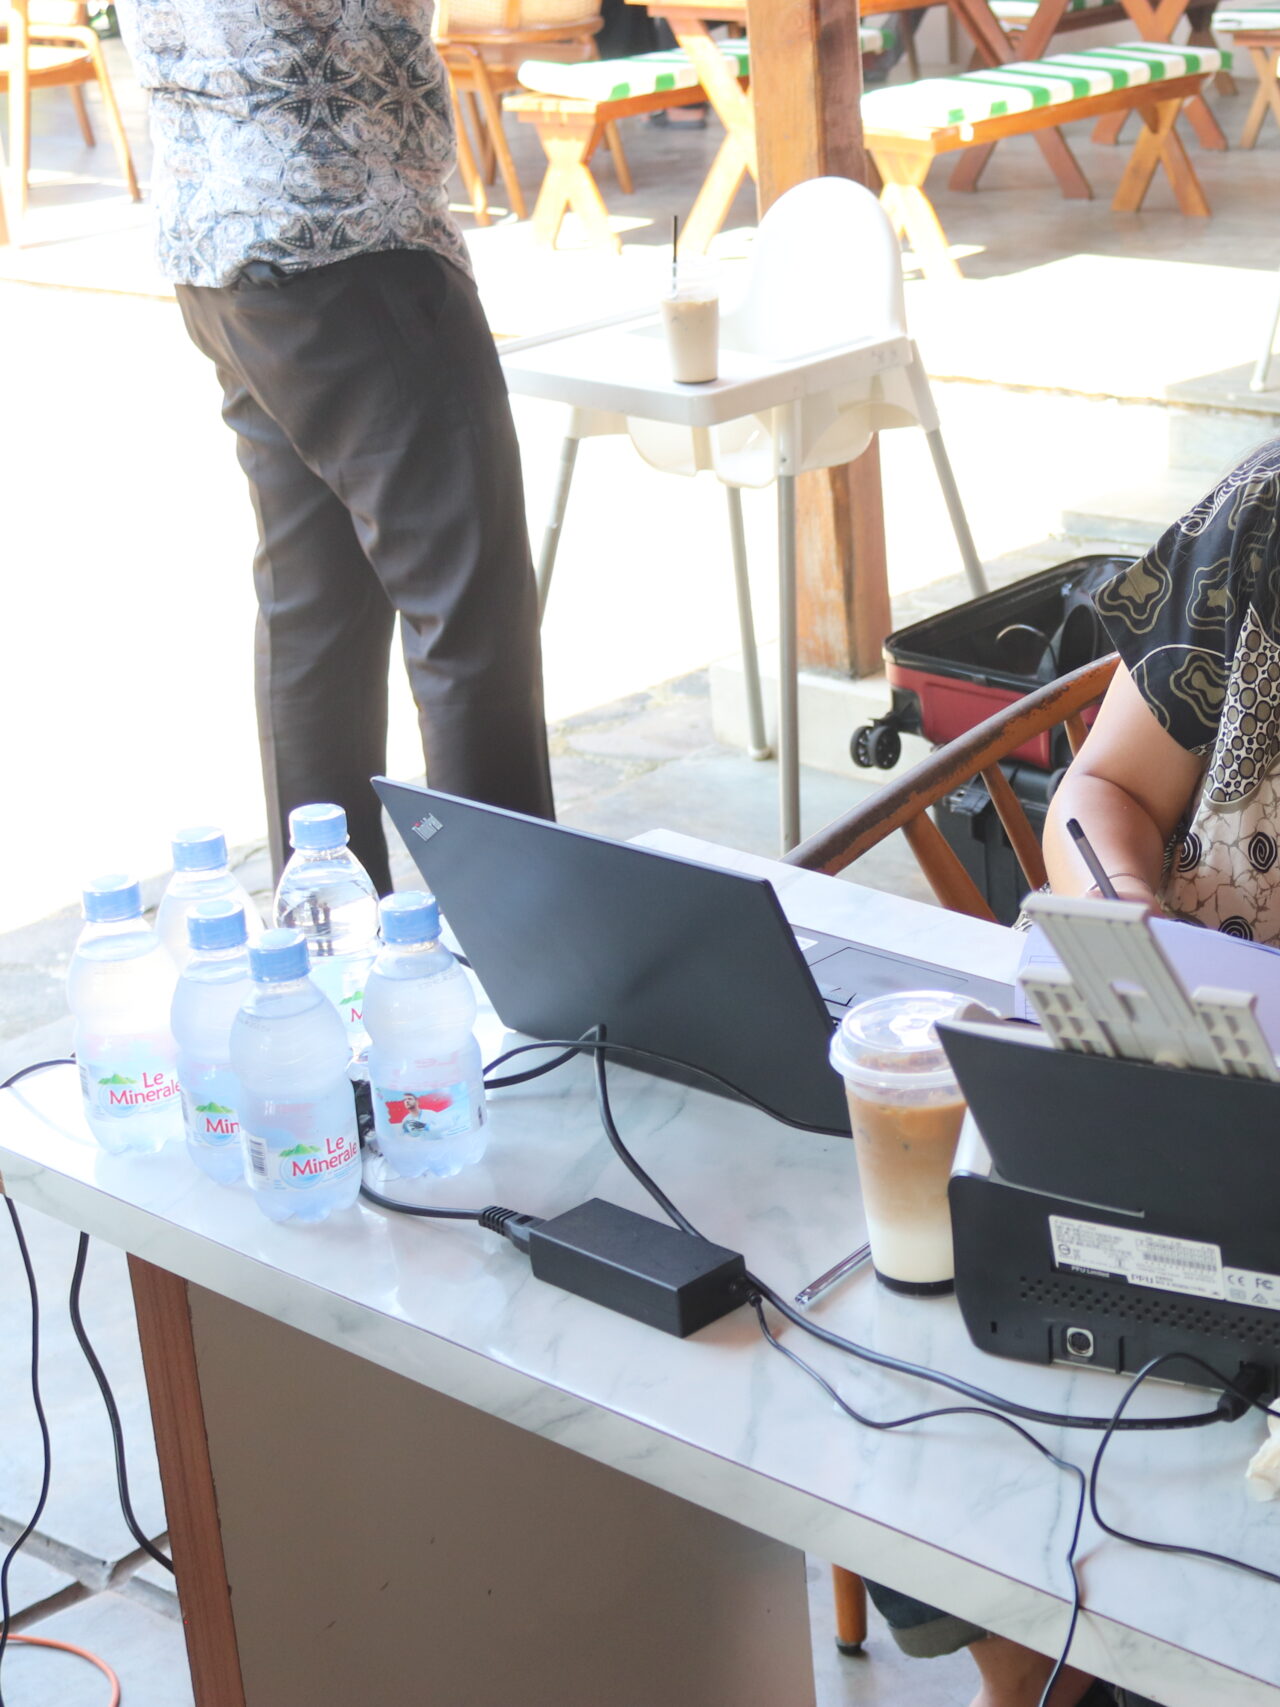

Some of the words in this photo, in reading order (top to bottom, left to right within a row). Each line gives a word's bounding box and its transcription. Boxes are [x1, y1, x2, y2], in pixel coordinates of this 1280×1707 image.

[142, 1072, 164, 1088] Le
[109, 1081, 181, 1105] Minerale
[325, 1136, 344, 1154] Le
[292, 1141, 357, 1177] Minerale
